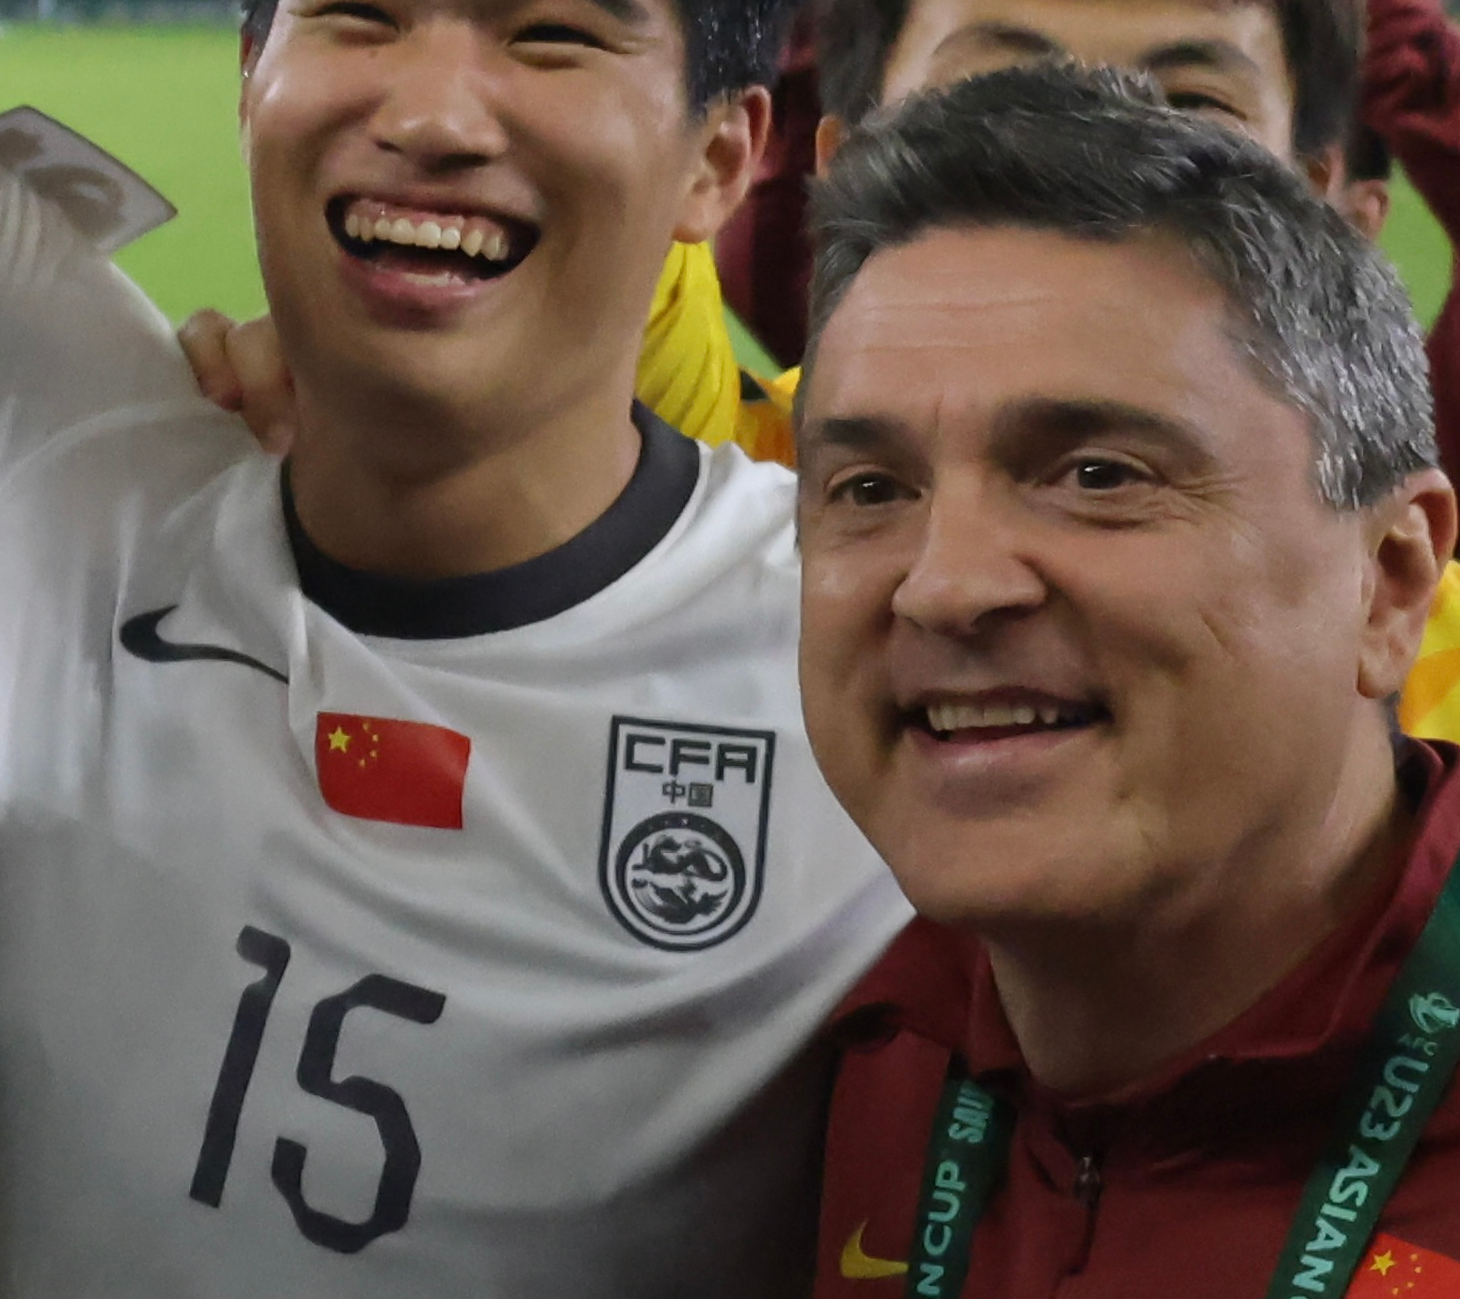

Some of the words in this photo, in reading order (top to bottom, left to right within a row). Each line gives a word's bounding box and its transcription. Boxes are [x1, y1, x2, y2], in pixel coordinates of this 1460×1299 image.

[624, 732, 758, 784] CFA
[188, 923, 447, 1255] 15
[1359, 1055, 1431, 1141] U23
[922, 1158, 967, 1257] CUP
[1291, 1143, 1381, 1294] ASIAN
